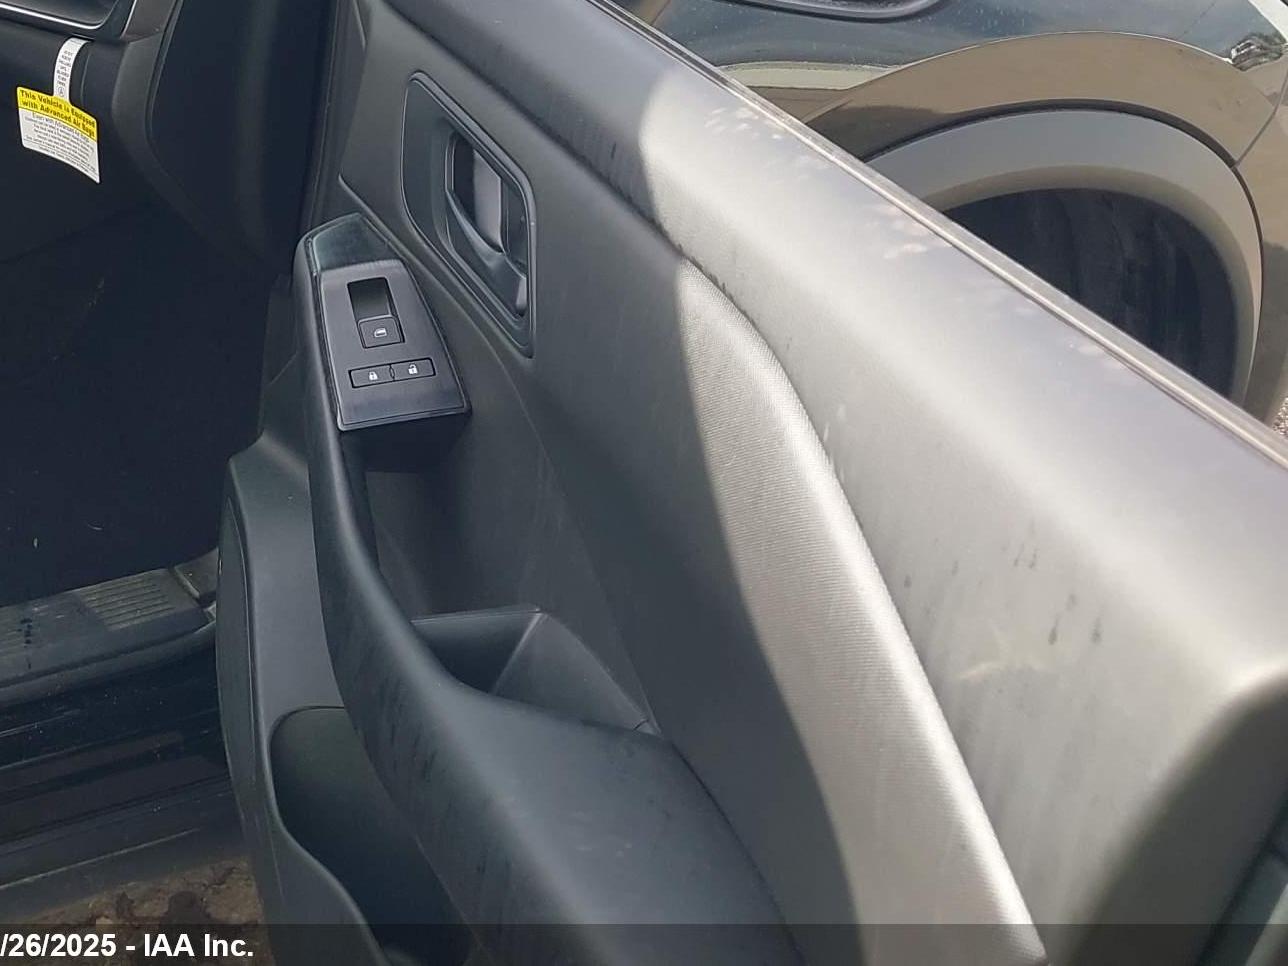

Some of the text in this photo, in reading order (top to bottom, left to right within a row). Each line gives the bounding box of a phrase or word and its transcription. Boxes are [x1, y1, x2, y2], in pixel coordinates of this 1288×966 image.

[20, 89, 37, 100] This
[37, 95, 63, 110] Vehicle
[64, 105, 70, 113] is
[22, 100, 95, 137] with Advanced Air Bags
